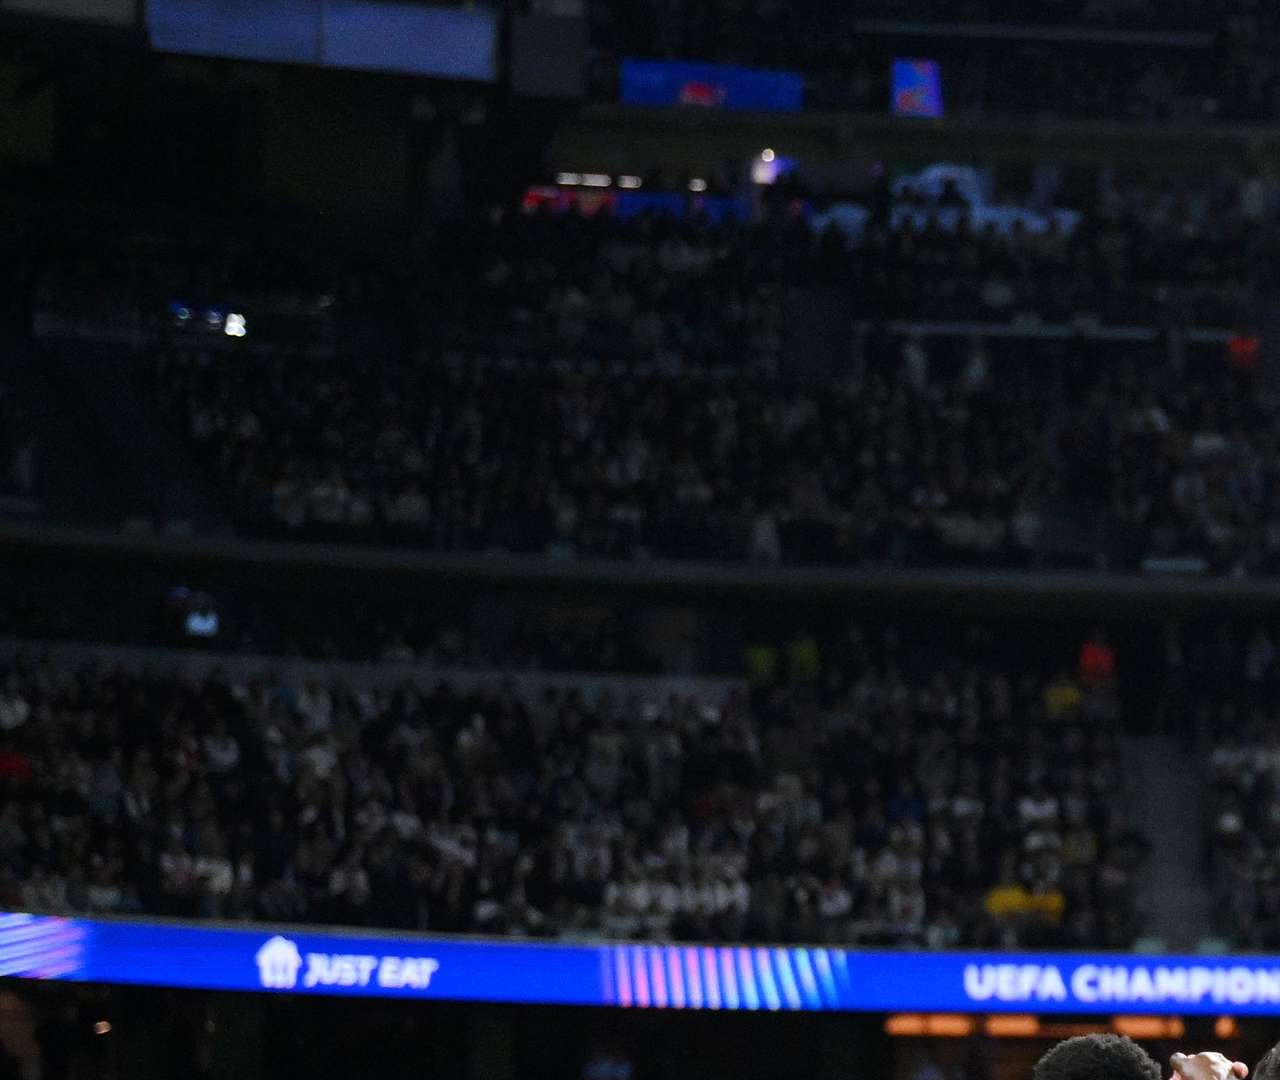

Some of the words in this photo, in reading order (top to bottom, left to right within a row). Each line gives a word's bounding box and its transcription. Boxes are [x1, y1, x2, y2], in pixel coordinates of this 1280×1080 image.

[303, 953, 378, 988] JUST
[378, 956, 440, 989] EAT
[964, 964, 1067, 1000] UEFA
